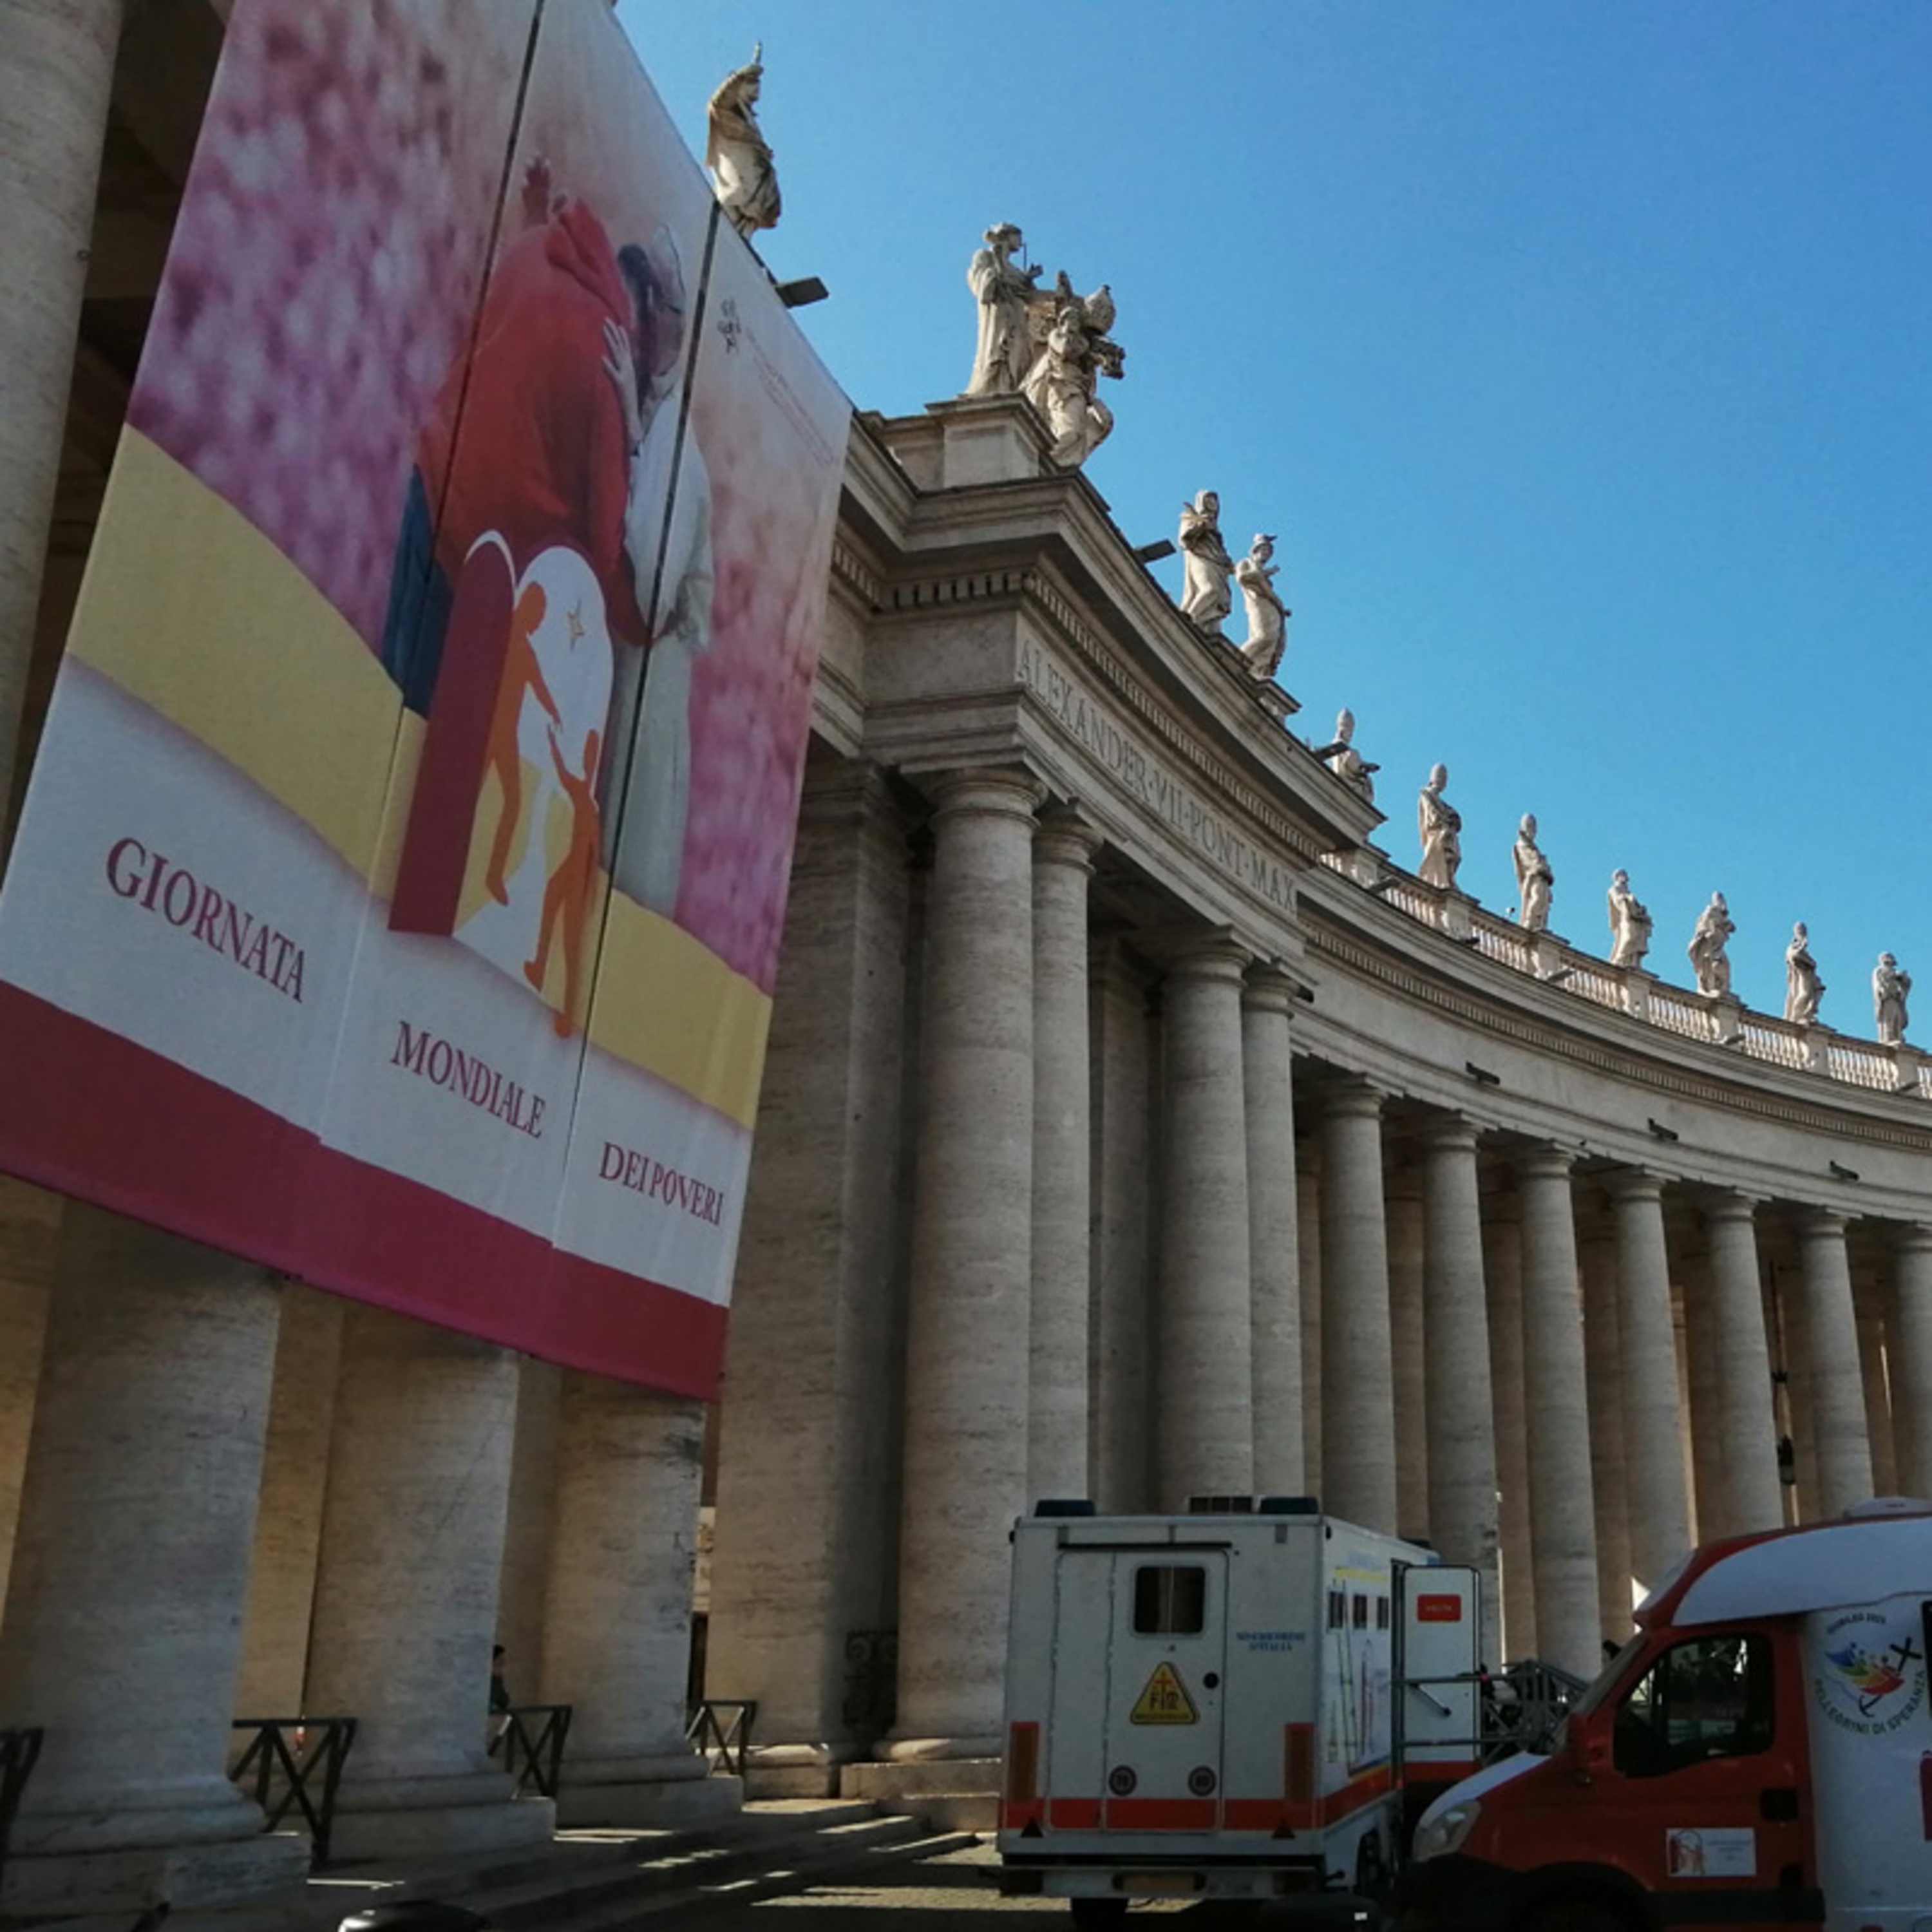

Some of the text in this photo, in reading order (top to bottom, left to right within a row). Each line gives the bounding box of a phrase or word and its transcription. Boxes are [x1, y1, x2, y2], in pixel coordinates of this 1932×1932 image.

[1016, 639, 1150, 803] ALEXANDER
[1189, 800, 1246, 877] PONT
[1251, 850, 1296, 914] MAX
[106, 837, 304, 1003] GIORNATA
[390, 1020, 545, 1139] MONDIALE
